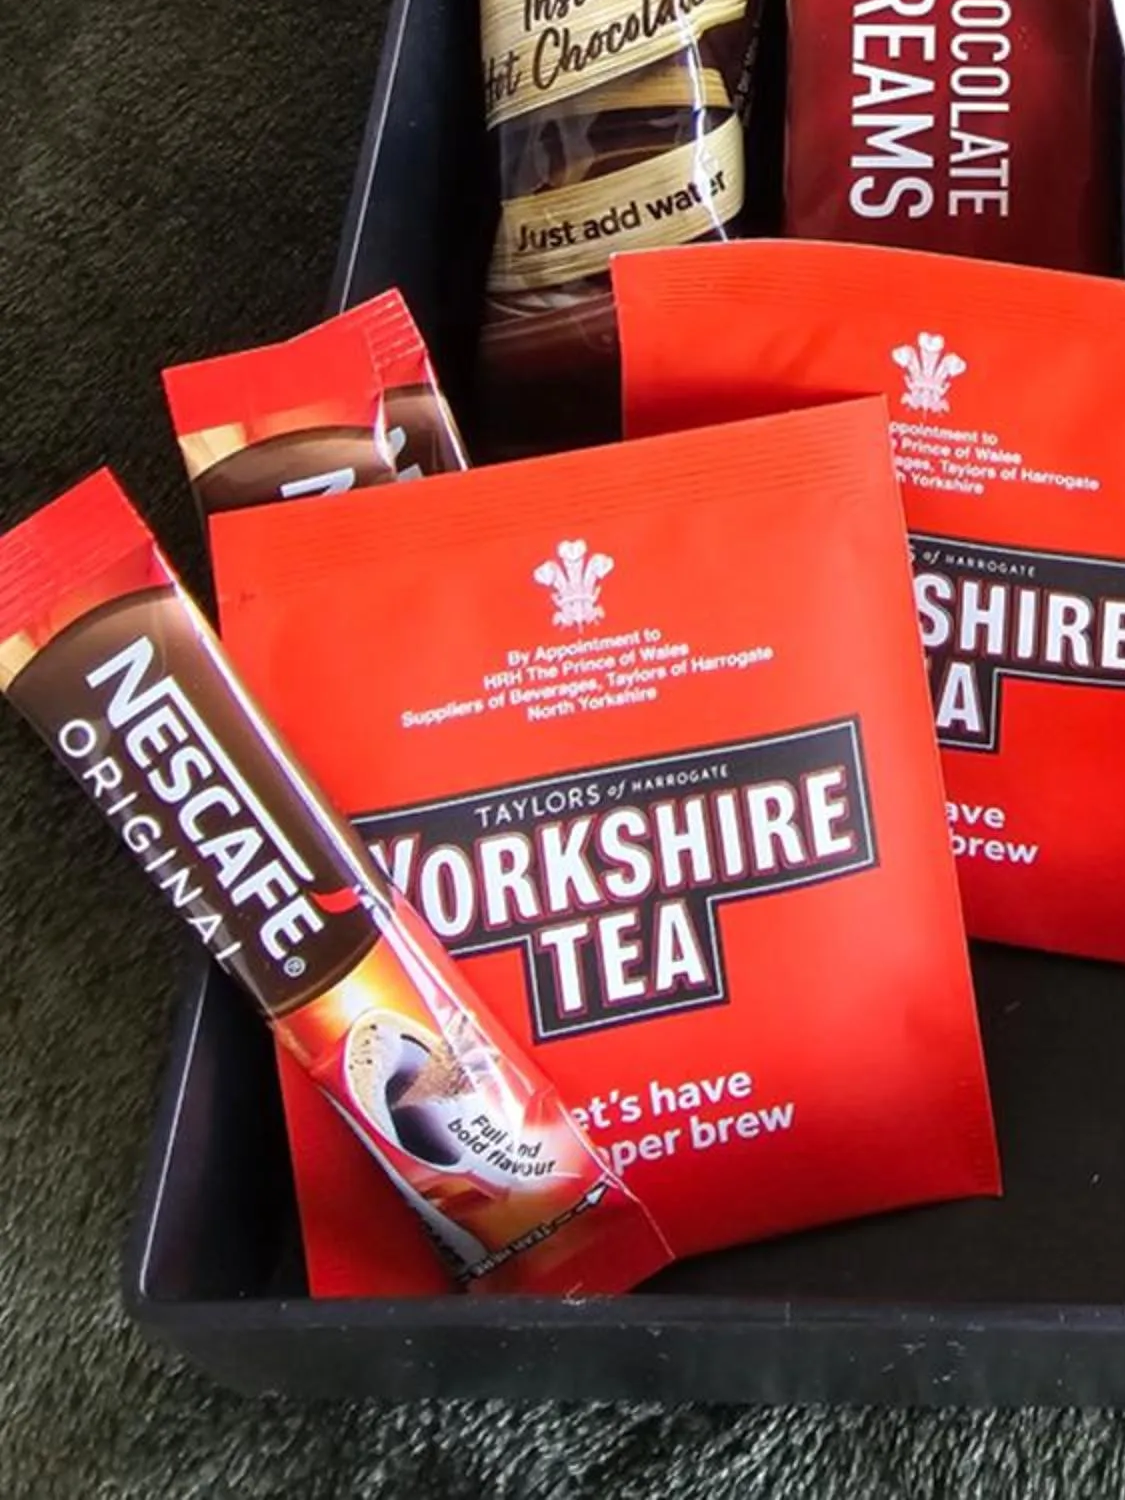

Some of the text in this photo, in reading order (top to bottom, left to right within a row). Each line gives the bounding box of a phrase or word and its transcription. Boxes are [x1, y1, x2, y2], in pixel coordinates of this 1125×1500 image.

[514, 217, 576, 253] Just
[583, 202, 642, 241] add
[888, 420, 978, 446] ppointment
[982, 430, 999, 447] to
[901, 437, 952, 458] Prince
[954, 445, 970, 460] of
[974, 446, 1023, 466] Wales
[911, 472, 986, 496] Yorkshire
[940, 460, 997, 480] Taylors
[1000, 467, 1017, 482] of
[1021, 467, 1100, 493] Harrogate
[945, 554, 1037, 579] HARROGATE
[484, 643, 690, 692] HRH The Prince of Wales
[507, 628, 662, 669] By Appointment to
[401, 699, 485, 730] Suppliers
[488, 692, 505, 710] of
[606, 666, 667, 688] Taylors
[671, 661, 689, 677] of
[691, 646, 774, 672] Harrogate
[527, 687, 658, 723] North Yorkshire
[474, 762, 730, 829] TAYLORS of HARROGATE
[945, 800, 1006, 830] ave
[57, 718, 242, 975] ORIGINAL
[368, 768, 855, 938] YORKSHIRE
[539, 902, 710, 1014] TEA
[570, 1070, 753, 1132] et's have
[447, 1118, 557, 1177] bold flavour
[470, 1113, 509, 1146] Full
[689, 1102, 795, 1150] brew
